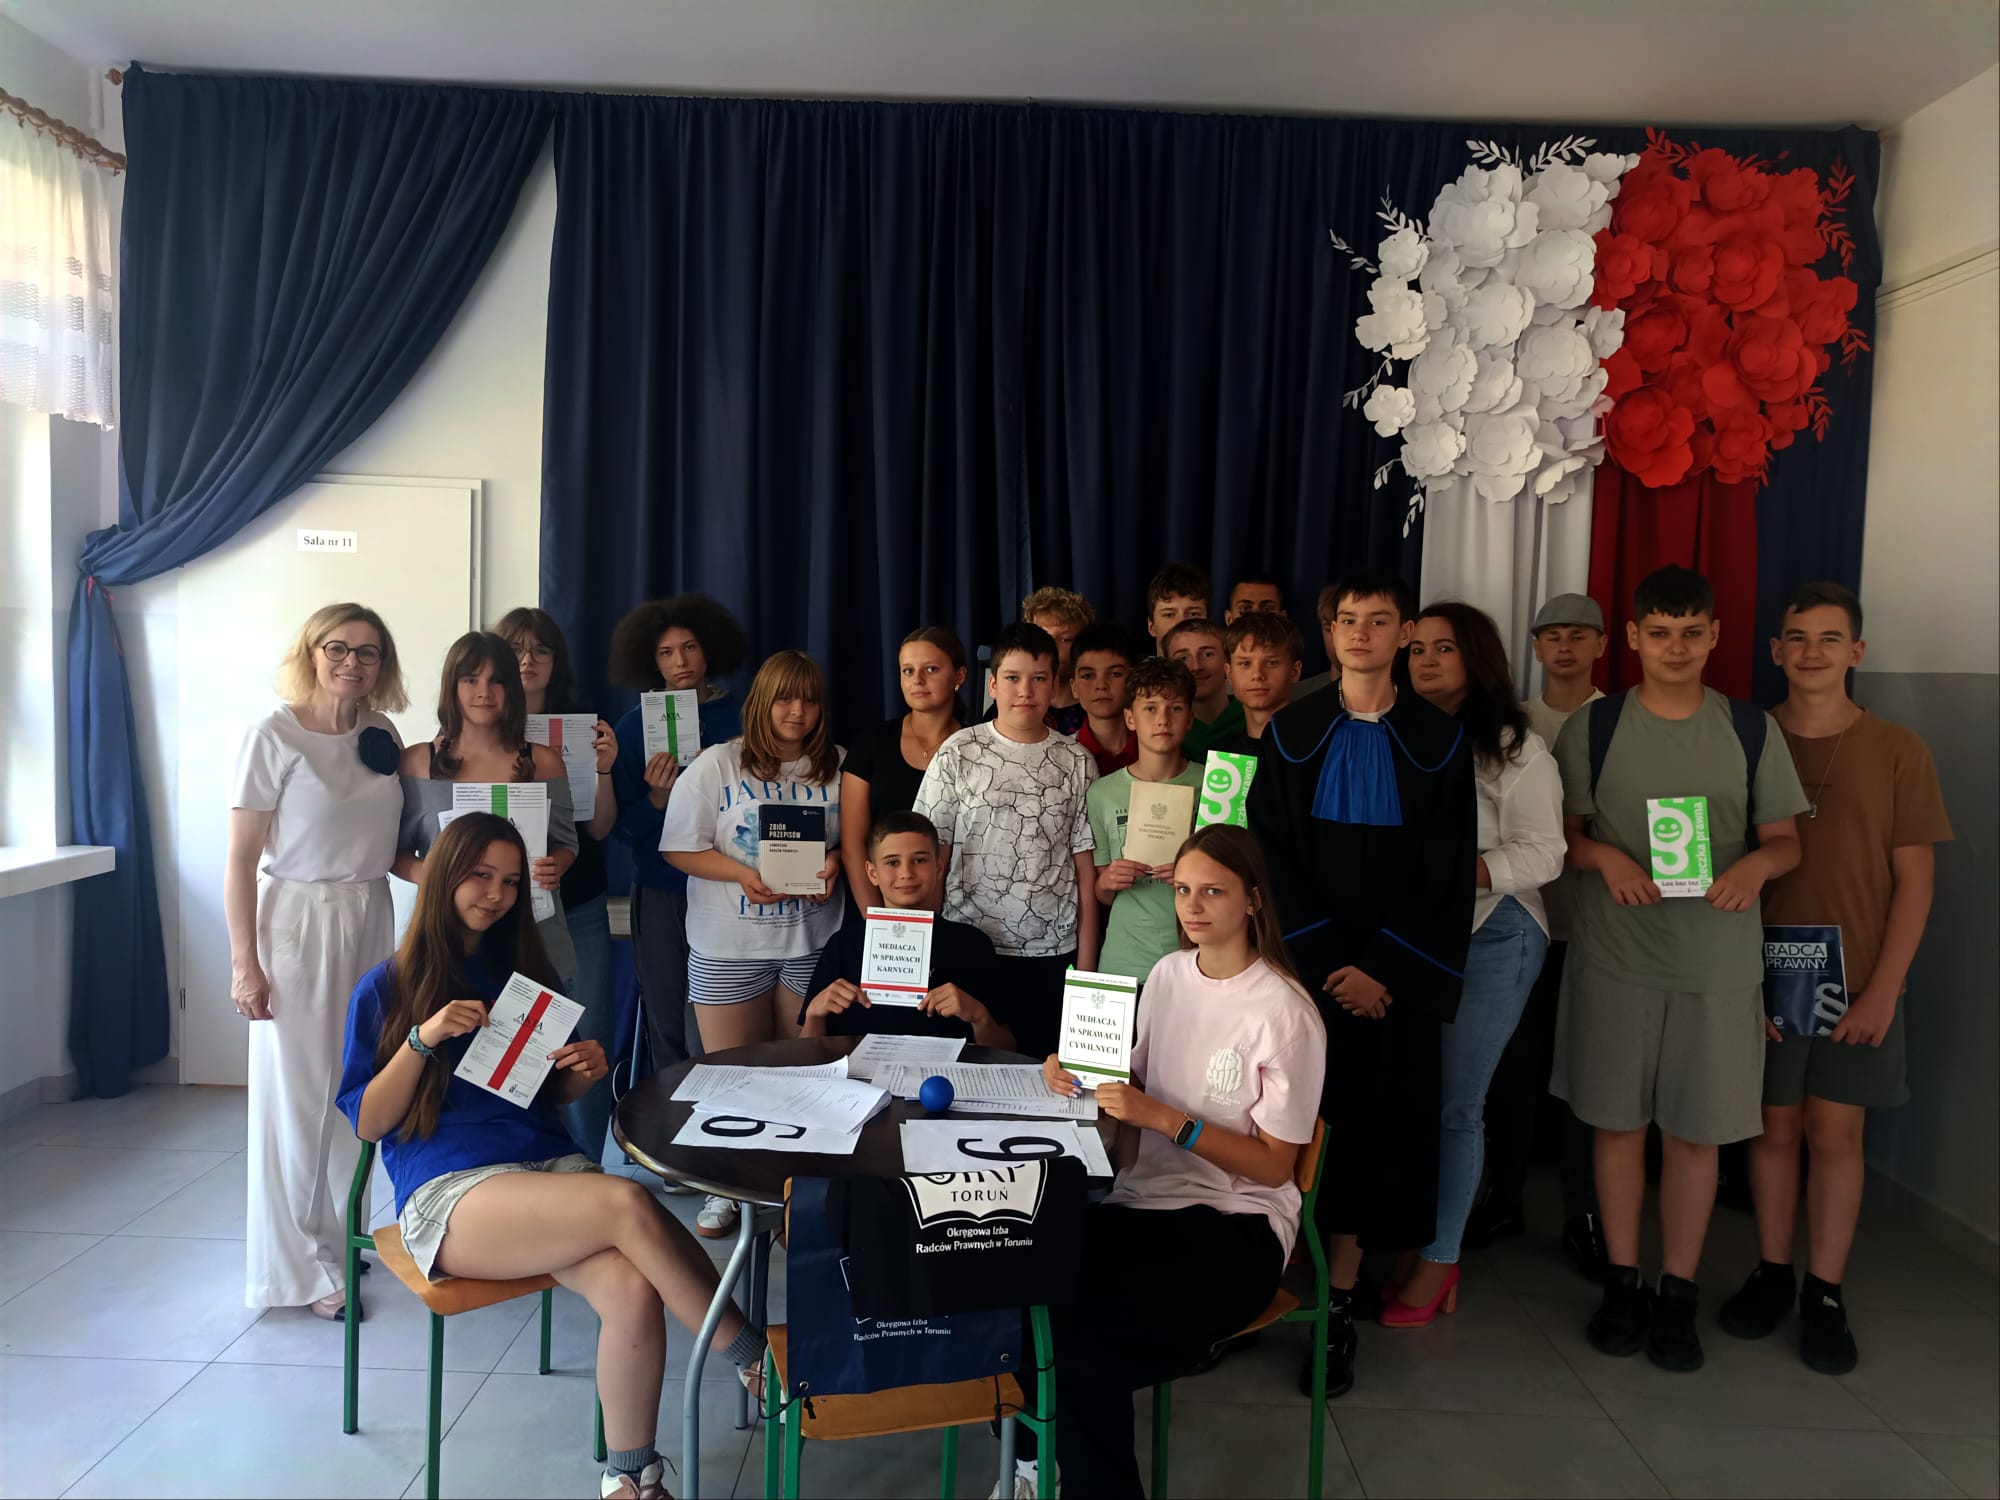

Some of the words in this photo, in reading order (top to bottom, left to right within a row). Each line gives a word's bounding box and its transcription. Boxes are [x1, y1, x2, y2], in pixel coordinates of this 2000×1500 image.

[303, 536, 325, 546] Sala
[342, 538, 352, 547] 11
[769, 822, 786, 830] ZBIÓR
[1694, 801, 1709, 842] prawna
[769, 830, 801, 839] PRZEPISÓW
[878, 942, 916, 952] MEDIACJA
[1766, 944, 1825, 956] RADCA
[880, 954, 921, 964] SPRAWACH
[1766, 958, 1828, 969] PRAWNY
[877, 965, 914, 974] KARNYCH
[1076, 1013, 1117, 1027] MEDIACJA
[1069, 1026, 1076, 1034] W
[1077, 1027, 1121, 1041] SPRAWACH
[1069, 1040, 1119, 1055] CYWILNYCH
[950, 1187, 1008, 1202] TORUŃ
[946, 1226, 991, 1240] Okręgowa
[992, 1225, 1009, 1236] Izba
[915, 1241, 952, 1254] Radców
[953, 1239, 995, 1252] Prawnych
[1003, 1237, 1033, 1247] Toruniu
[876, 1319, 912, 1329] Okręgowa
[912, 1317, 928, 1326] Izba
[853, 1330, 880, 1341] Radców
[881, 1328, 915, 1339] Prawnych
[924, 1326, 952, 1336] Toruniu
